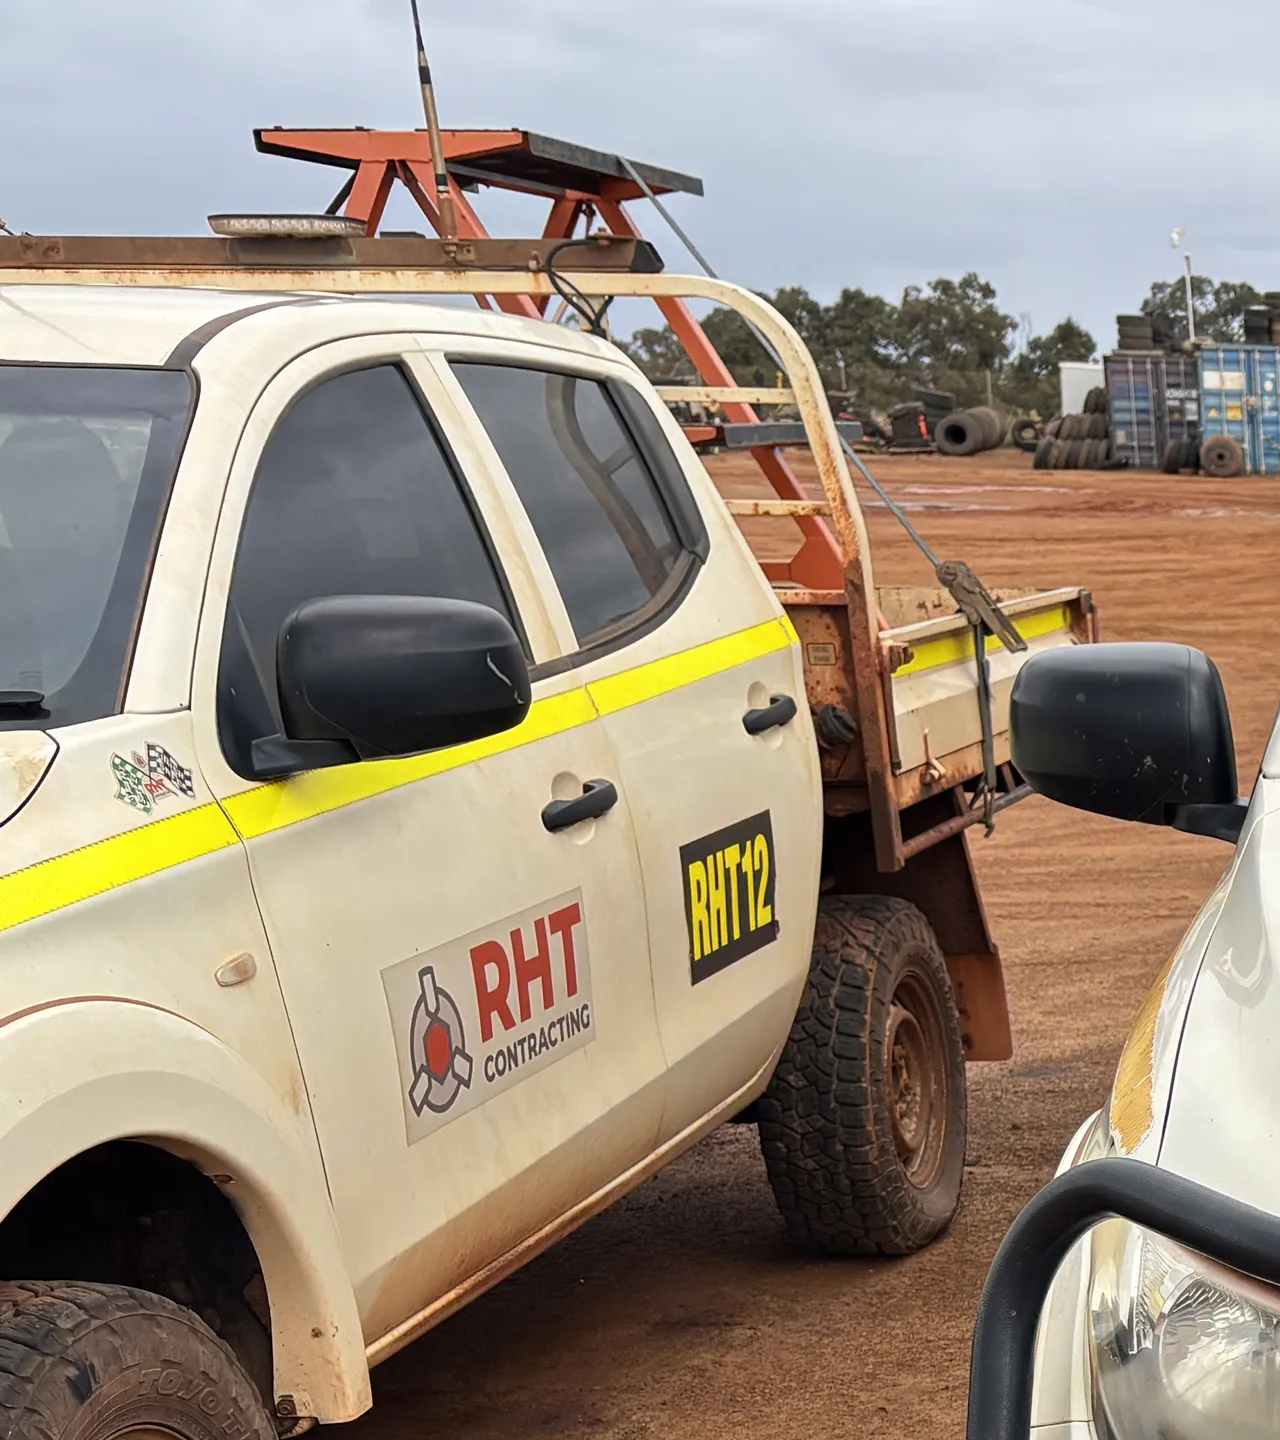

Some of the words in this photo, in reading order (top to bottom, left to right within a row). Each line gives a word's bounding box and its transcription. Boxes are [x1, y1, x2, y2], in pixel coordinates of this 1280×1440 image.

[688, 833, 772, 961] RHT12
[468, 901, 582, 1044] RHT
[483, 1002, 591, 1083] CONTRACTING
